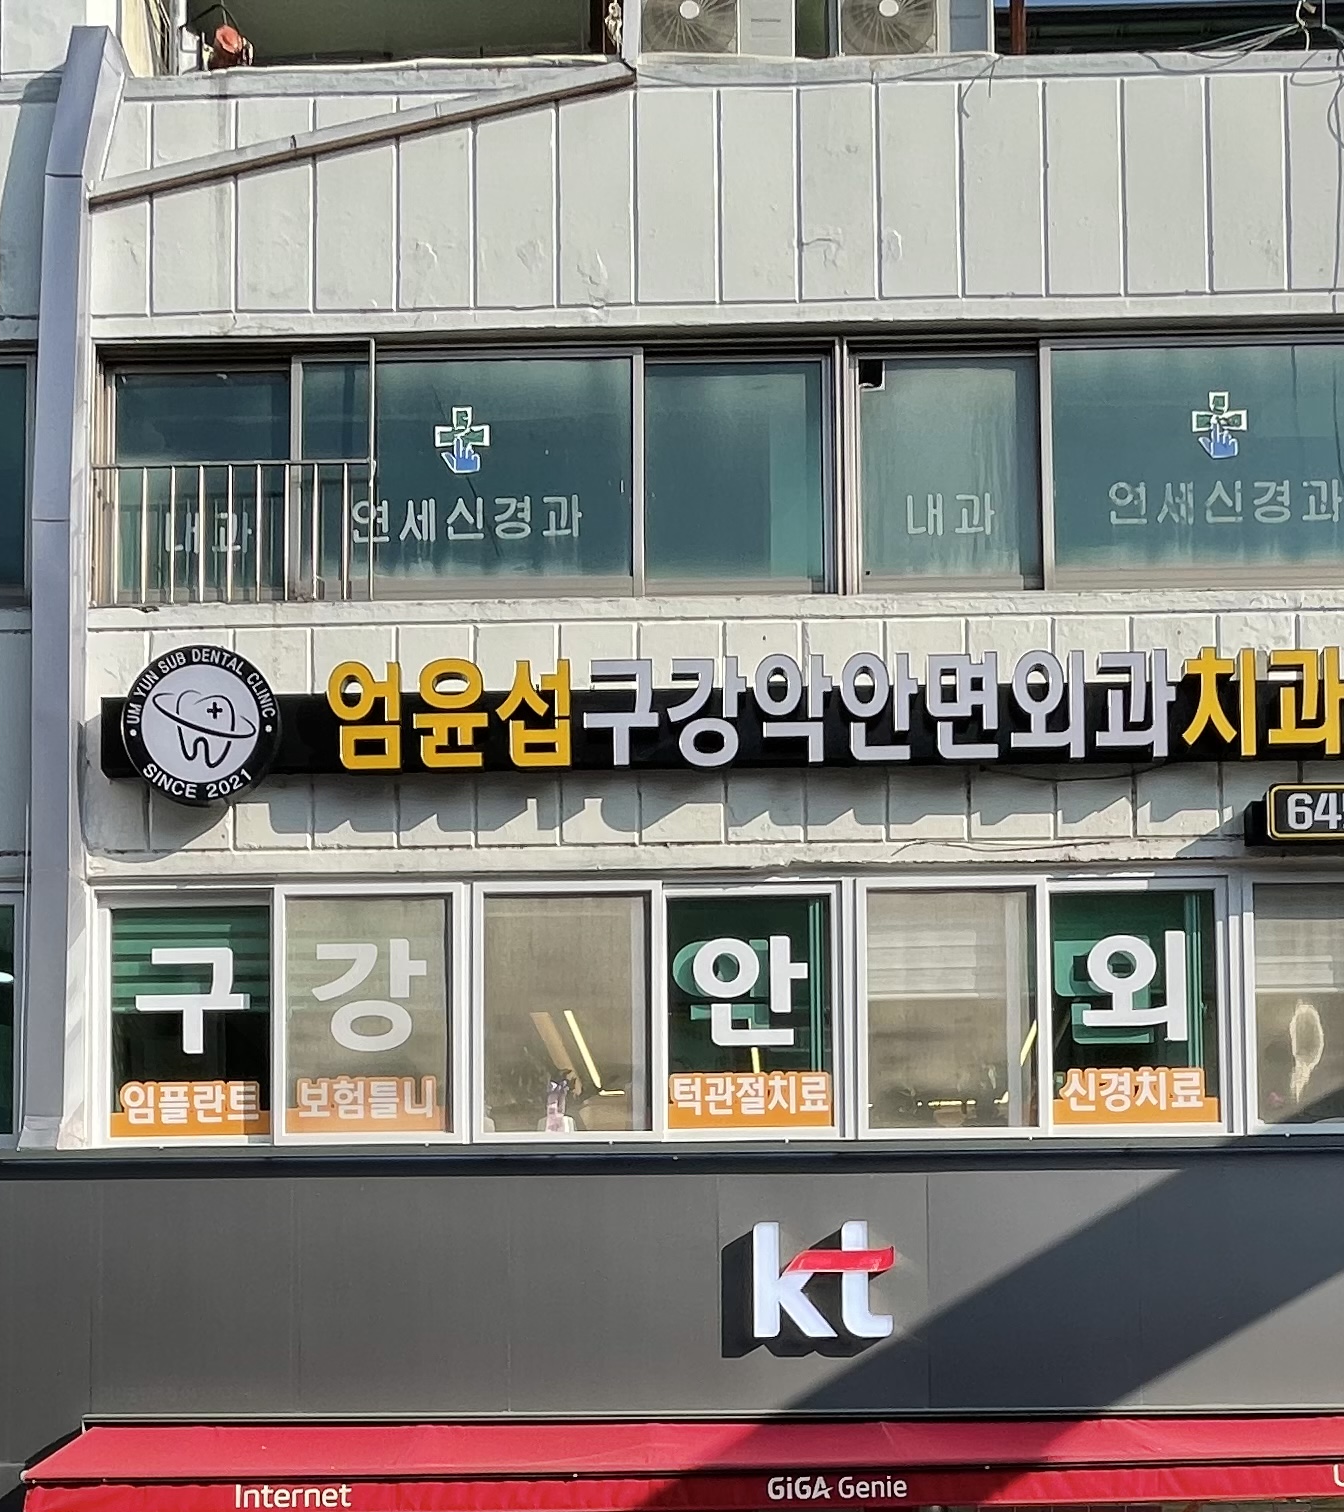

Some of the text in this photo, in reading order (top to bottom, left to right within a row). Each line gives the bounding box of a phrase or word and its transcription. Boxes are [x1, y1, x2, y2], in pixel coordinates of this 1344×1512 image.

[350, 494, 584, 542] 연세신경과
[907, 491, 995, 538] 내과
[1107, 479, 1344, 525] 연세신경과
[165, 510, 252, 554] 내과
[126, 648, 276, 724] UM YUN SUB DENTAL CLINIC
[326, 658, 573, 771] 엄윤섭
[582, 649, 1176, 768] 구강악안면외과
[143, 763, 252, 798] SINCE 2021
[135, 930, 1186, 1055] 구 강 안 외
[121, 1081, 261, 1125] 임플란트
[297, 1079, 435, 1119] 보험틀니
[671, 1075, 830, 1116] 턱관절치료
[1061, 1069, 1206, 1112] 신경치료
[753, 1220, 895, 1338] kt
[234, 1483, 353, 1509] Internet
[767, 1474, 908, 1501] GiGA Genie
